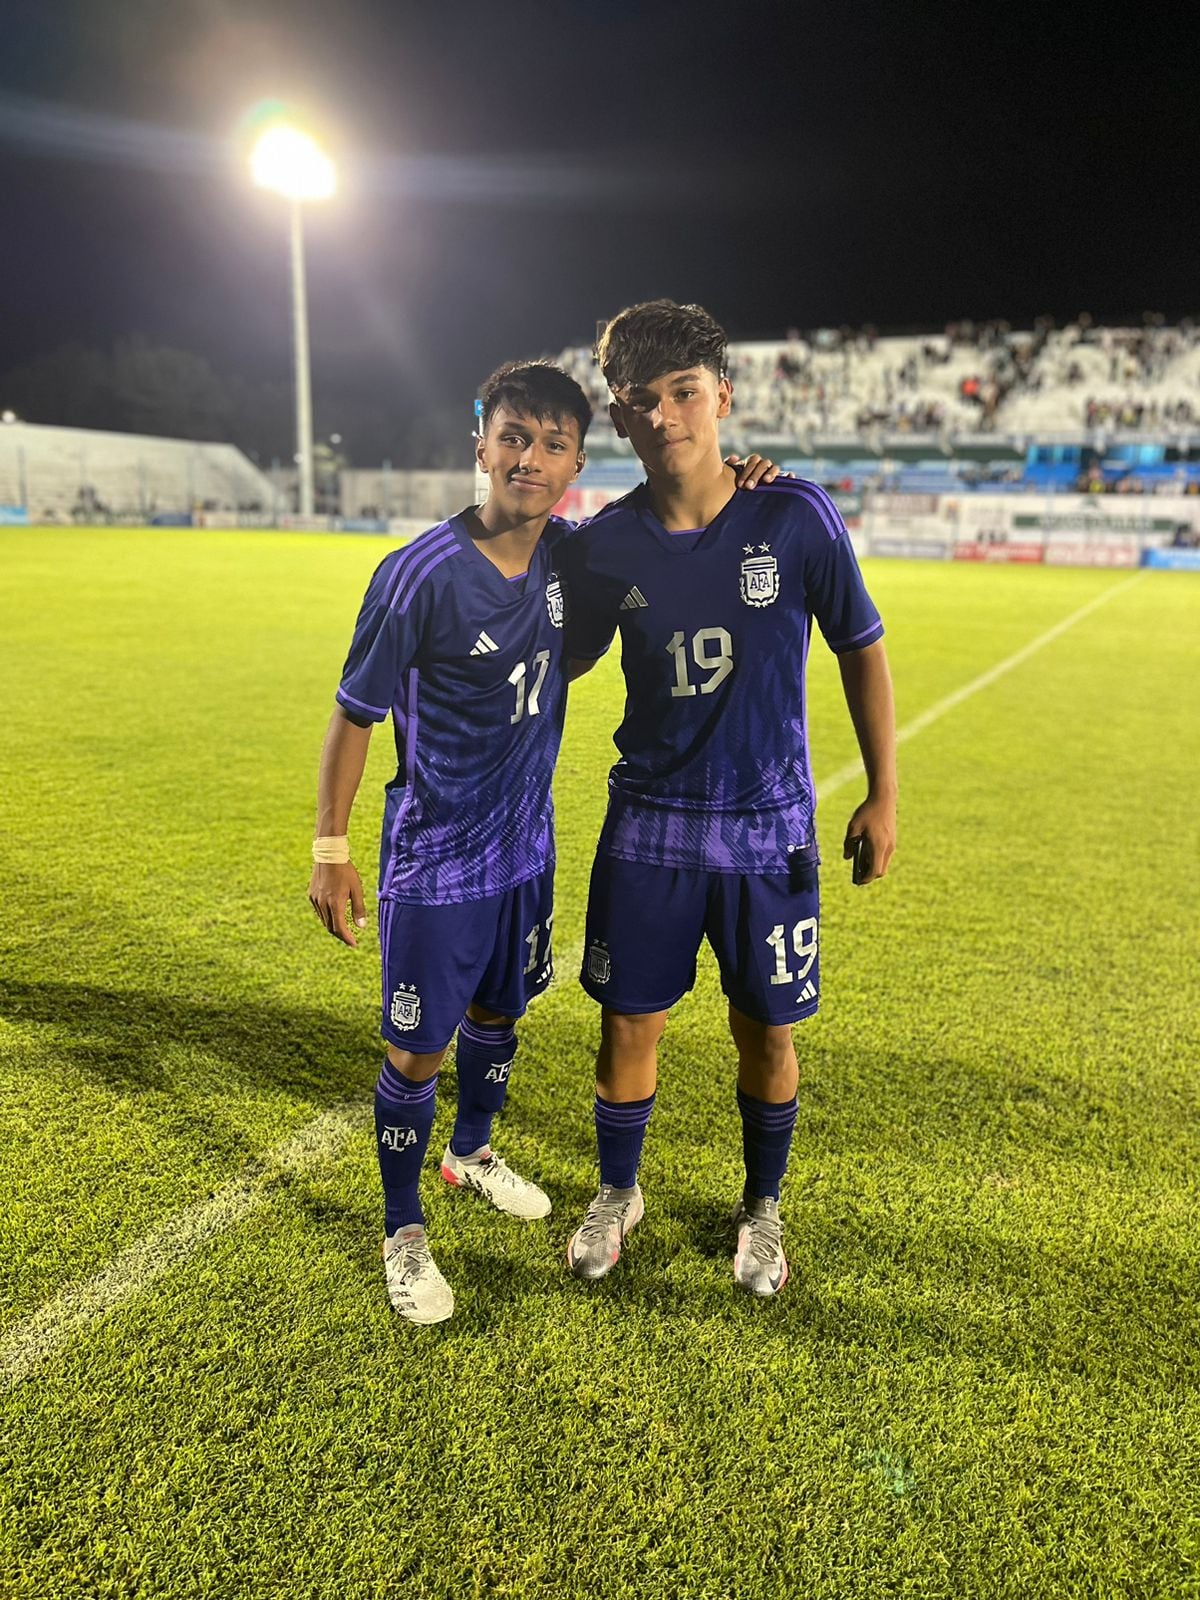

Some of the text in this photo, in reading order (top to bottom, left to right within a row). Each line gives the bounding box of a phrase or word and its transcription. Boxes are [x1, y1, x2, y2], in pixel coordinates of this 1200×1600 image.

[750, 571, 771, 592] AFA
[665, 627, 733, 697] 19
[507, 649, 550, 725] 17
[765, 916, 818, 985] 19
[397, 1002, 413, 1019] AFA
[381, 1125, 418, 1152] AFA
